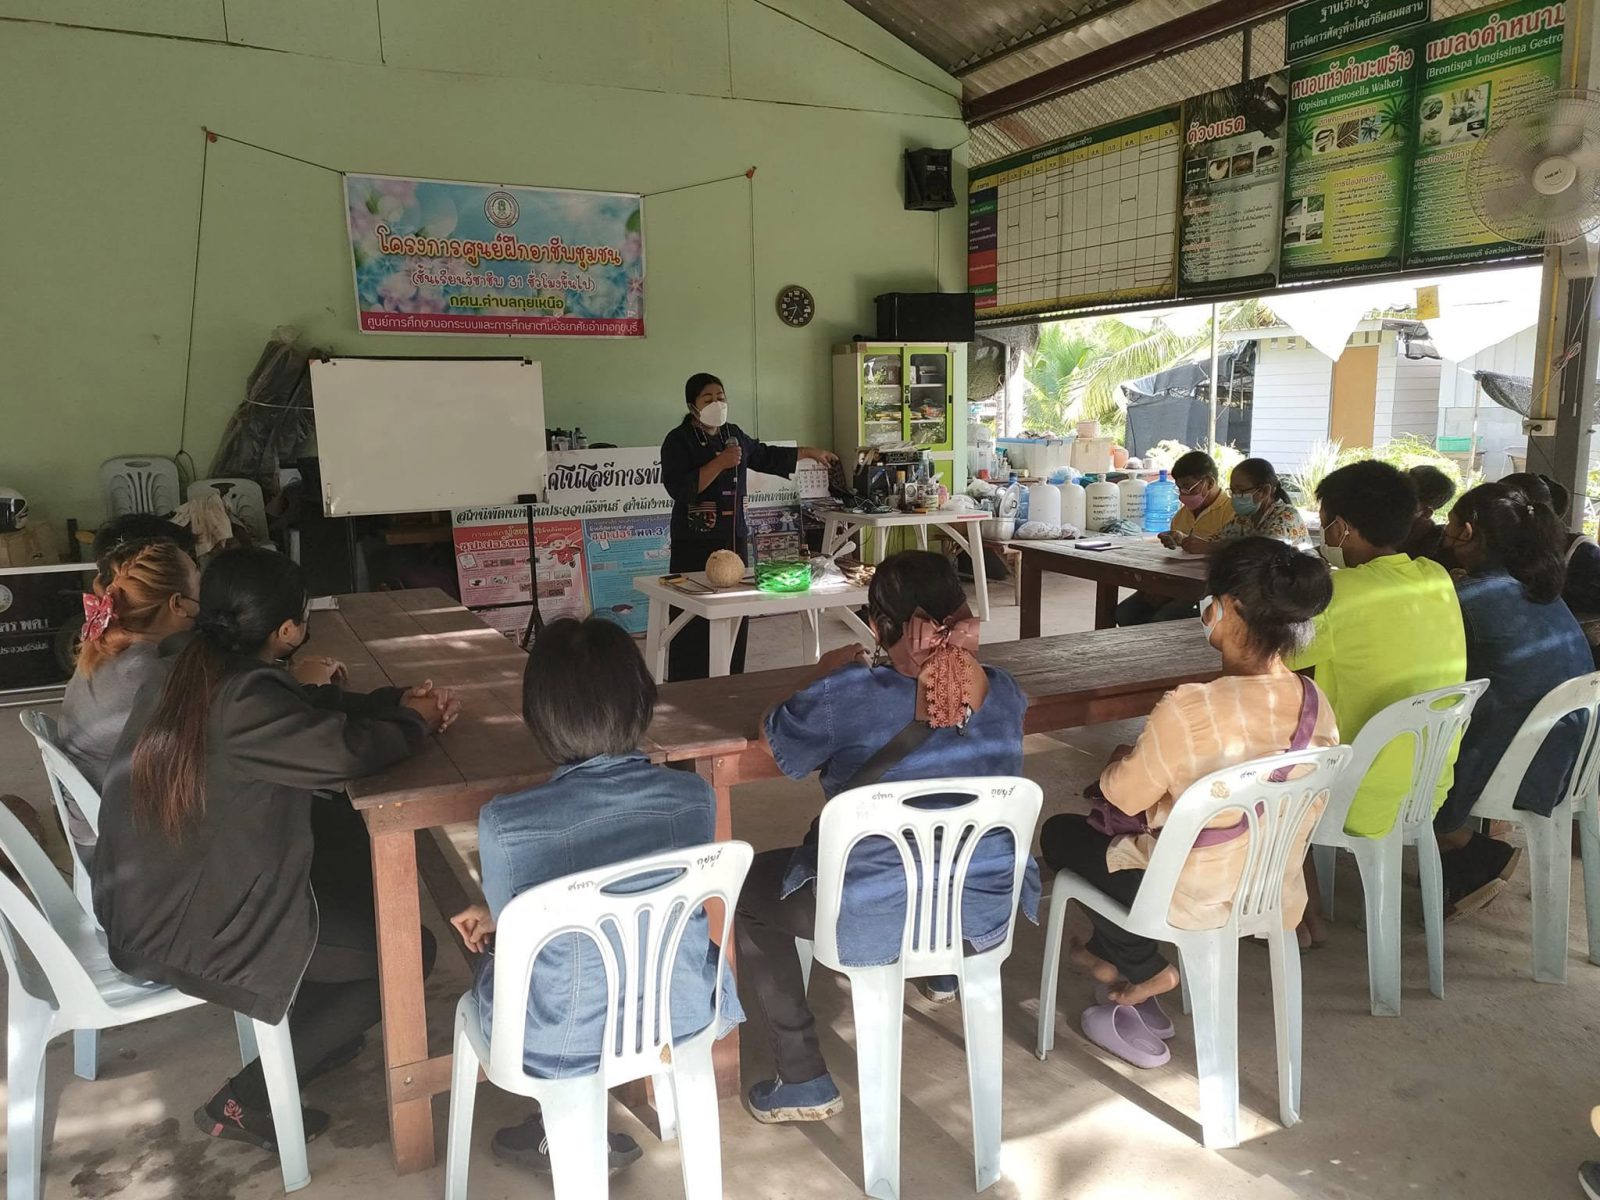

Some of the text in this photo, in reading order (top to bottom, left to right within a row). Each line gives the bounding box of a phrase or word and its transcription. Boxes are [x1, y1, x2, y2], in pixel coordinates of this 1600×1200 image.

[1290, 1, 1424, 50] การจัดการศัตรูพืชโดยวิธีผสมผสาน
[1292, 45, 1414, 100] หนอนหัวดำมะพร้าว
[1426, 59, 1472, 80] (Brontispa
[1475, 44, 1526, 65] longissima
[1298, 76, 1403, 113] (Opisina arenosella Walker)
[377, 225, 622, 269] โครงการศูนย์ฝึกอาชีพชุมชน
[509, 275, 523, 288] 31
[449, 294, 565, 311] กศน.ตำบลกุยเหนือ
[547, 461, 663, 492] คโนโลยีการพั
